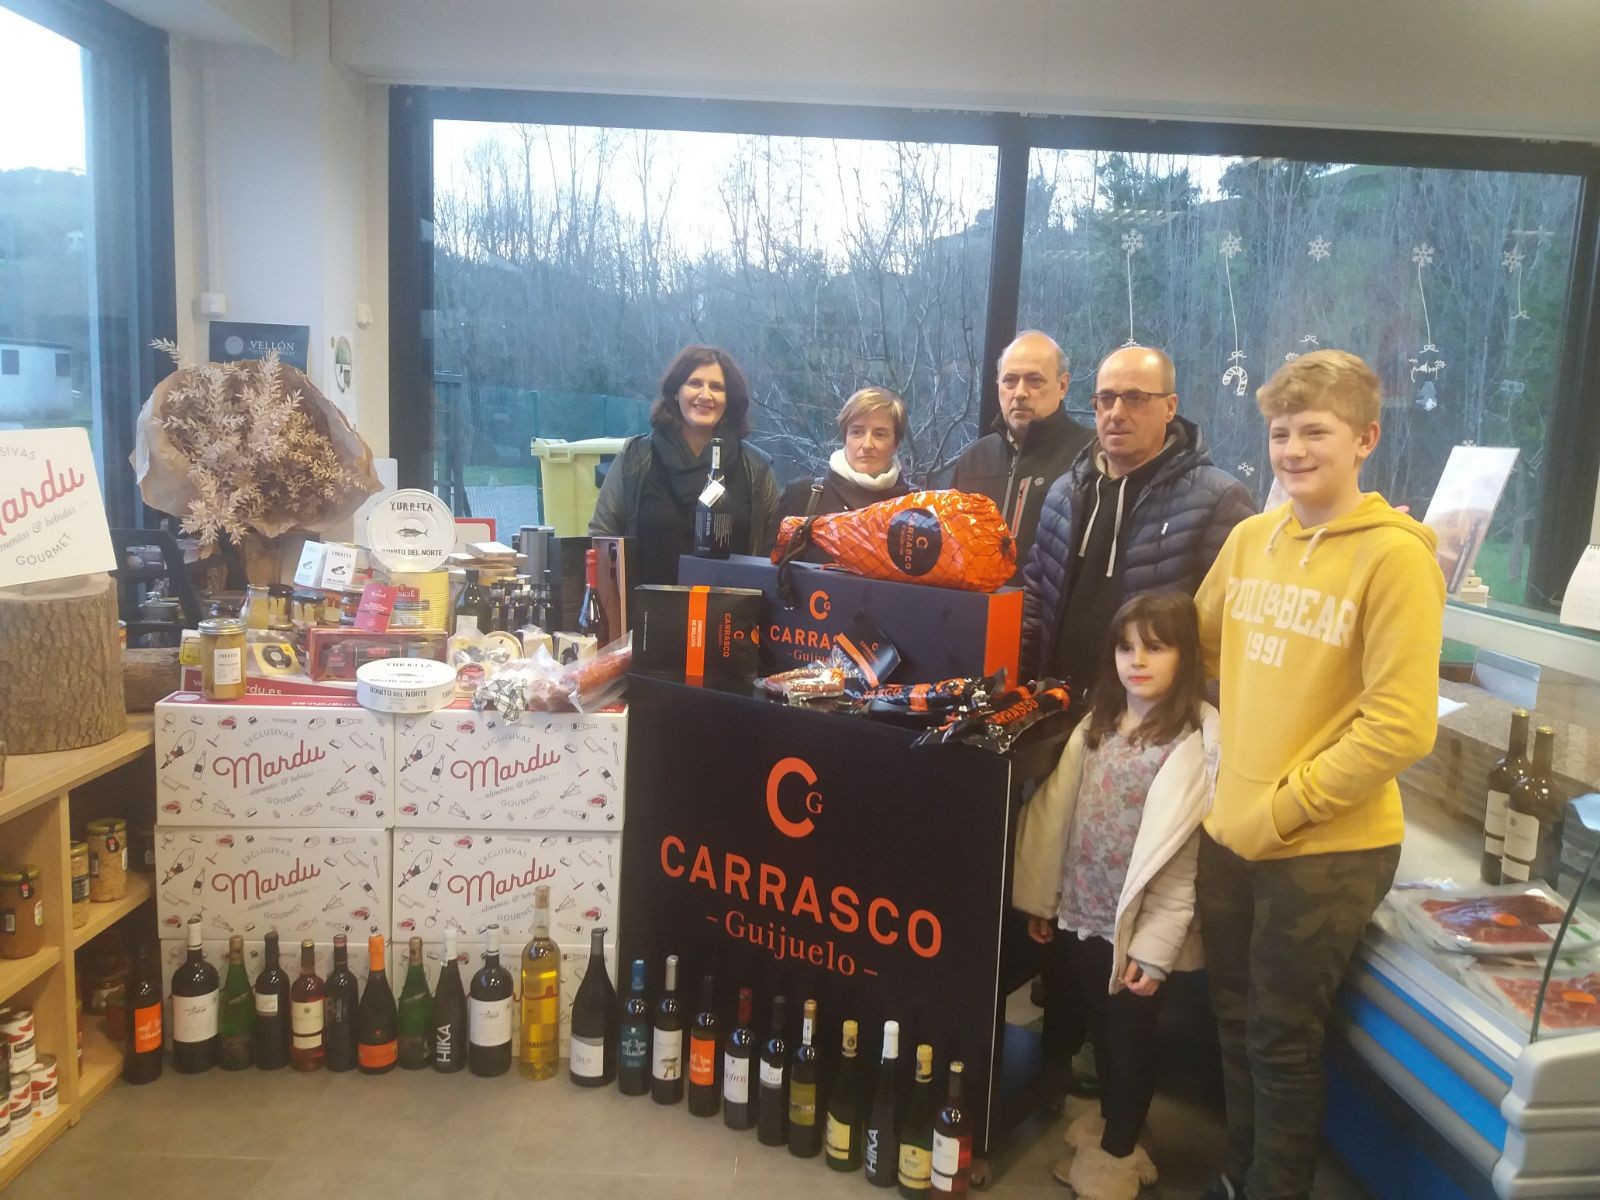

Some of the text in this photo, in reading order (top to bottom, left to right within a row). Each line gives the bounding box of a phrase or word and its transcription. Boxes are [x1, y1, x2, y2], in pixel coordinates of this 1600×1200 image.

[249, 339, 295, 351] VELLÓN
[0, 459, 85, 536] ardu
[390, 501, 434, 512] YURRITA
[15, 531, 72, 566] GOURMET
[421, 549, 443, 557] NORTE
[722, 613, 732, 658] CARRASCO
[770, 625, 838, 651] CARRA
[1246, 630, 1288, 668] 1991
[405, 690, 428, 698] NORTE
[243, 728, 295, 747] EXCLUSIVAS
[212, 739, 326, 789] Mardu
[450, 743, 561, 791] Mardu
[265, 787, 306, 805] GOURMET
[501, 789, 540, 807] GOURMET
[241, 847, 291, 865] EXCLUSIVAS
[478, 847, 527, 865] EXCLUSIVAS
[211, 857, 321, 904] Mardu
[447, 857, 556, 906] Mardu
[660, 835, 942, 959] CARRASCO
[497, 903, 535, 921] GOURME
[725, 909, 855, 977] Guijuelo
[437, 1024, 451, 1063] HIKA
[866, 1129, 879, 1173] HIKA
